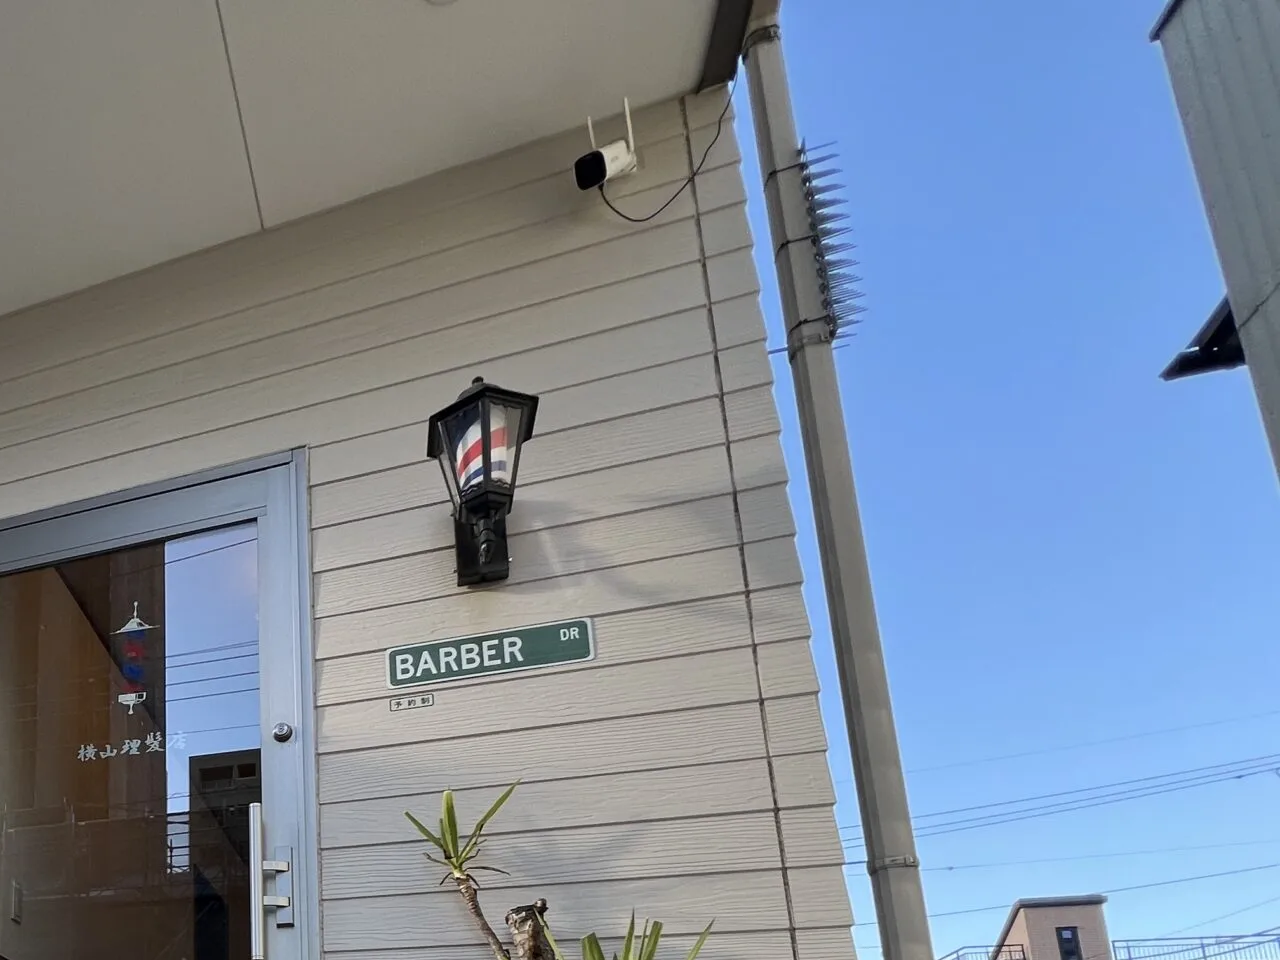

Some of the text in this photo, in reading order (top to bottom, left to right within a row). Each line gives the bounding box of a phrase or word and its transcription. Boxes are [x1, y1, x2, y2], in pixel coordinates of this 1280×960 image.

[395, 627, 580, 680] BARBER DR
[394, 696, 431, 709] 予約制
